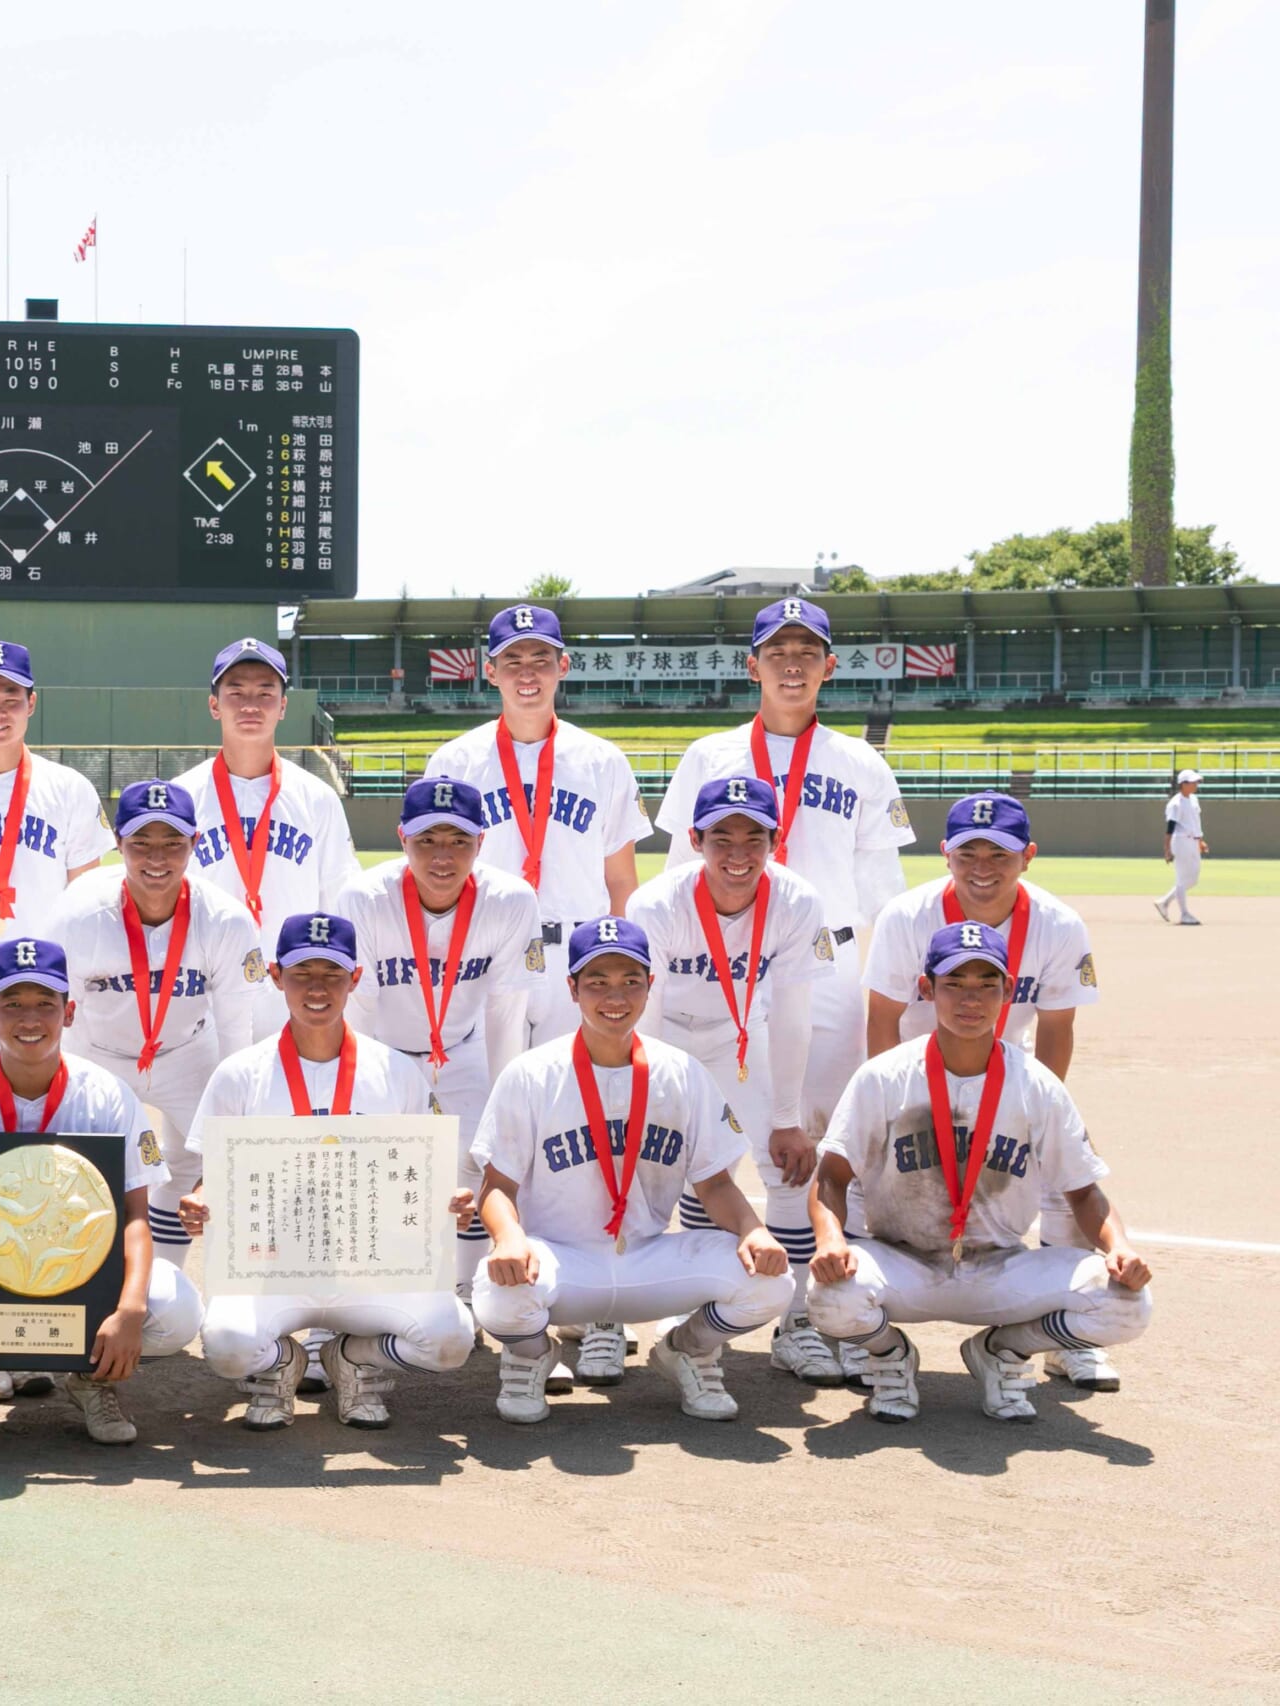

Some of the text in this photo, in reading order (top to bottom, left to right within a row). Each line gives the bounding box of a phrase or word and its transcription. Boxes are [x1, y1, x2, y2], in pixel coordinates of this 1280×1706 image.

[8, 340, 16, 350] R
[28, 341, 37, 350] H
[48, 341, 55, 351] E
[110, 346, 118, 356] B
[171, 348, 179, 357] H
[243, 350, 298, 360] UMPIRE
[6, 358, 23, 370] 10
[28, 358, 41, 370] 15
[51, 359, 55, 370] 1
[110, 362, 118, 372] S
[171, 363, 178, 373] E
[277, 365, 289, 375] 2B
[9, 376, 17, 389] 0
[29, 376, 38, 389] 9
[48, 377, 57, 389] 0
[110, 377, 119, 388] O
[167, 379, 182, 389] Fc
[210, 379, 331, 392] 1B 日下部 3B 中山
[293, 416, 332, 428] 帝京大可児
[269, 434, 332, 446] 1 9 池田
[79, 442, 118, 454] 池田
[267, 450, 273, 459] 2
[281, 450, 289, 460] 6
[267, 465, 331, 477] 3 4 平岩
[35, 480, 74, 493] 平岩
[281, 481, 289, 491] 3
[293, 480, 331, 492] 横井
[267, 495, 331, 508] 5 7 細江
[194, 517, 219, 528] TIME
[266, 512, 272, 521] 6
[281, 512, 289, 522] 8
[58, 532, 97, 544] 横井
[267, 528, 272, 536] 7
[280, 527, 290, 537] H
[206, 533, 233, 544] 2:38
[266, 541, 331, 554] 8 2 羽石
[266, 557, 331, 569] 9 5 倉田
[0, 566, 40, 580] 羽石
[148, 785, 167, 809] G
[728, 780, 747, 802] G
[972, 800, 993, 823] G
[309, 918, 330, 943] G
[598, 919, 618, 942] G
[960, 925, 981, 948] G
[16, 941, 36, 966] G
[388, 1148, 400, 1182] 優勝
[402, 1166, 419, 1227] 表彰状
[15, 1326, 60, 1338] 優勝
